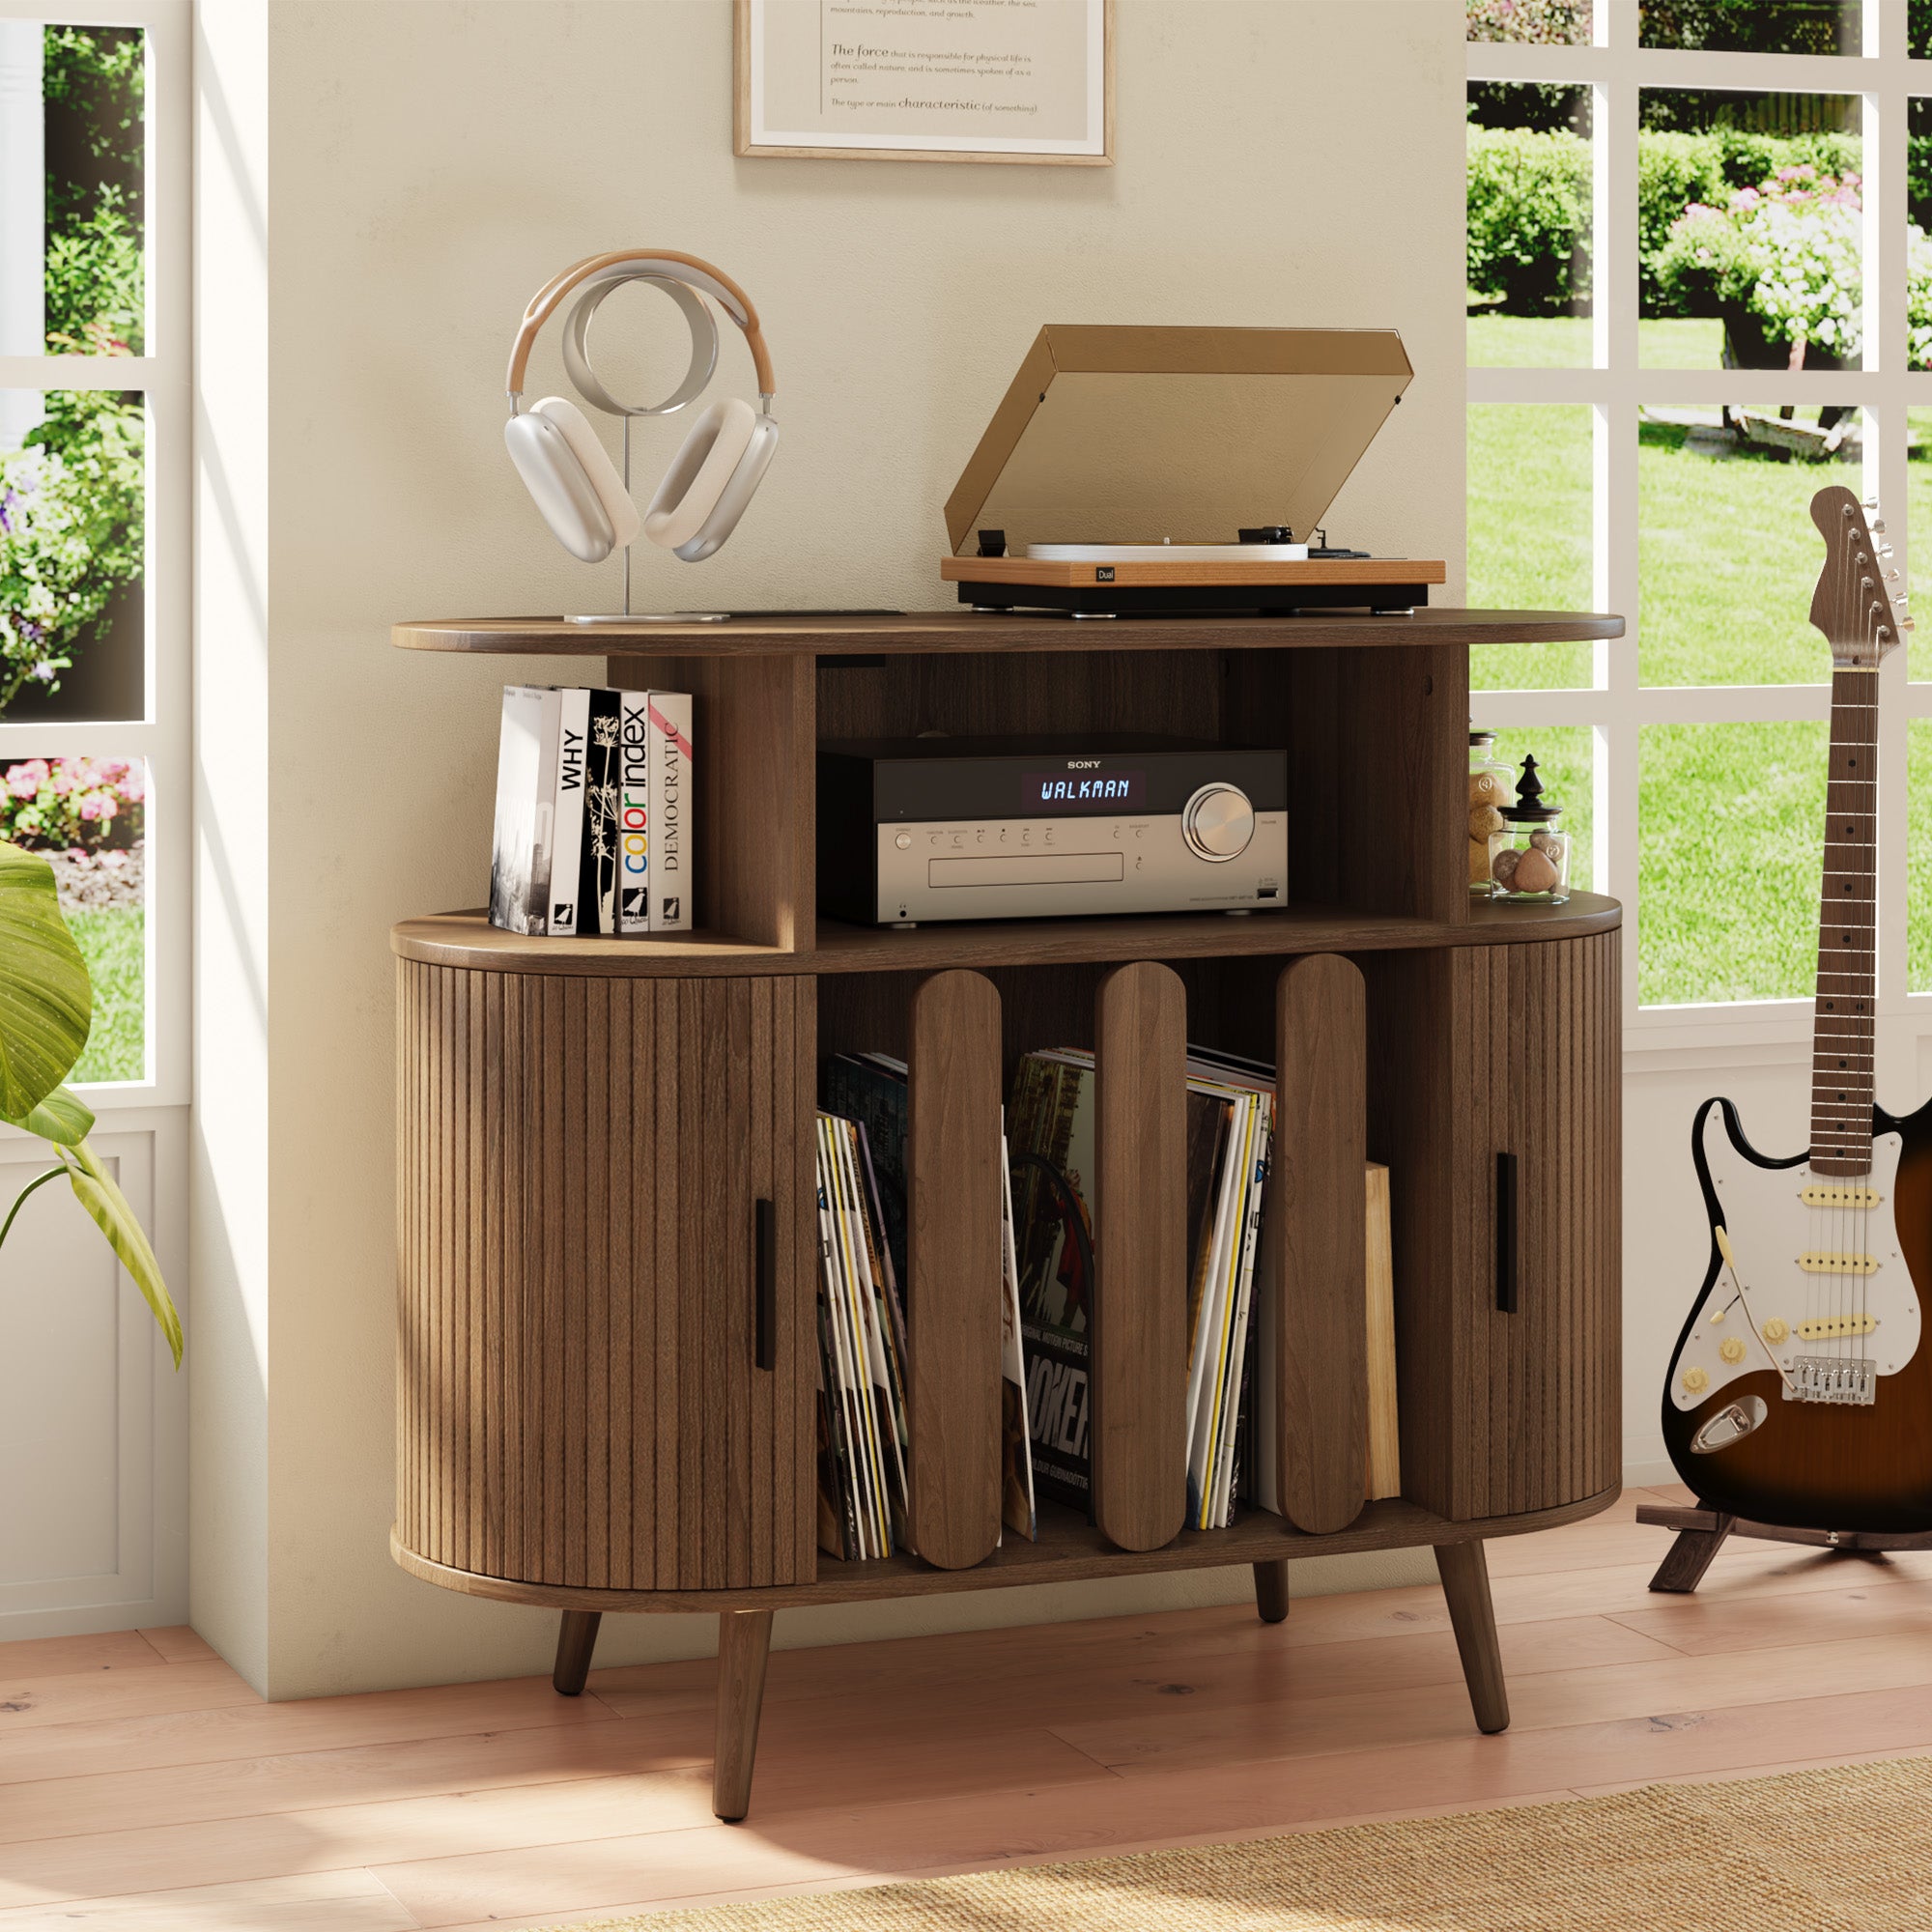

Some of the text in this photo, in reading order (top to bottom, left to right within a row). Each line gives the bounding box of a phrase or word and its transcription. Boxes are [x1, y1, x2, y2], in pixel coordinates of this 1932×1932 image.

[832, 43, 854, 56] The
[855, 44, 889, 61] force
[891, 49, 907, 58] that
[917, 52, 962, 62] responsible
[963, 52, 975, 62] for
[976, 53, 1009, 65] physical
[1009, 54, 1023, 64] life
[830, 62, 851, 71] often
[852, 62, 877, 71] called
[977, 68, 1004, 77] spoken
[1005, 68, 1013, 77] of
[831, 98, 846, 106] The
[846, 99, 865, 109] type
[897, 97, 980, 111] characteristic
[981, 102, 994, 114] (of
[1098, 569, 1114, 580] Dual
[561, 729, 583, 791] WHY
[1066, 760, 1101, 770] SONY
[620, 705, 647, 874] color index
[664, 721, 680, 871] DEMOCRATIC
[1040, 780, 1129, 800] WALKMAN
